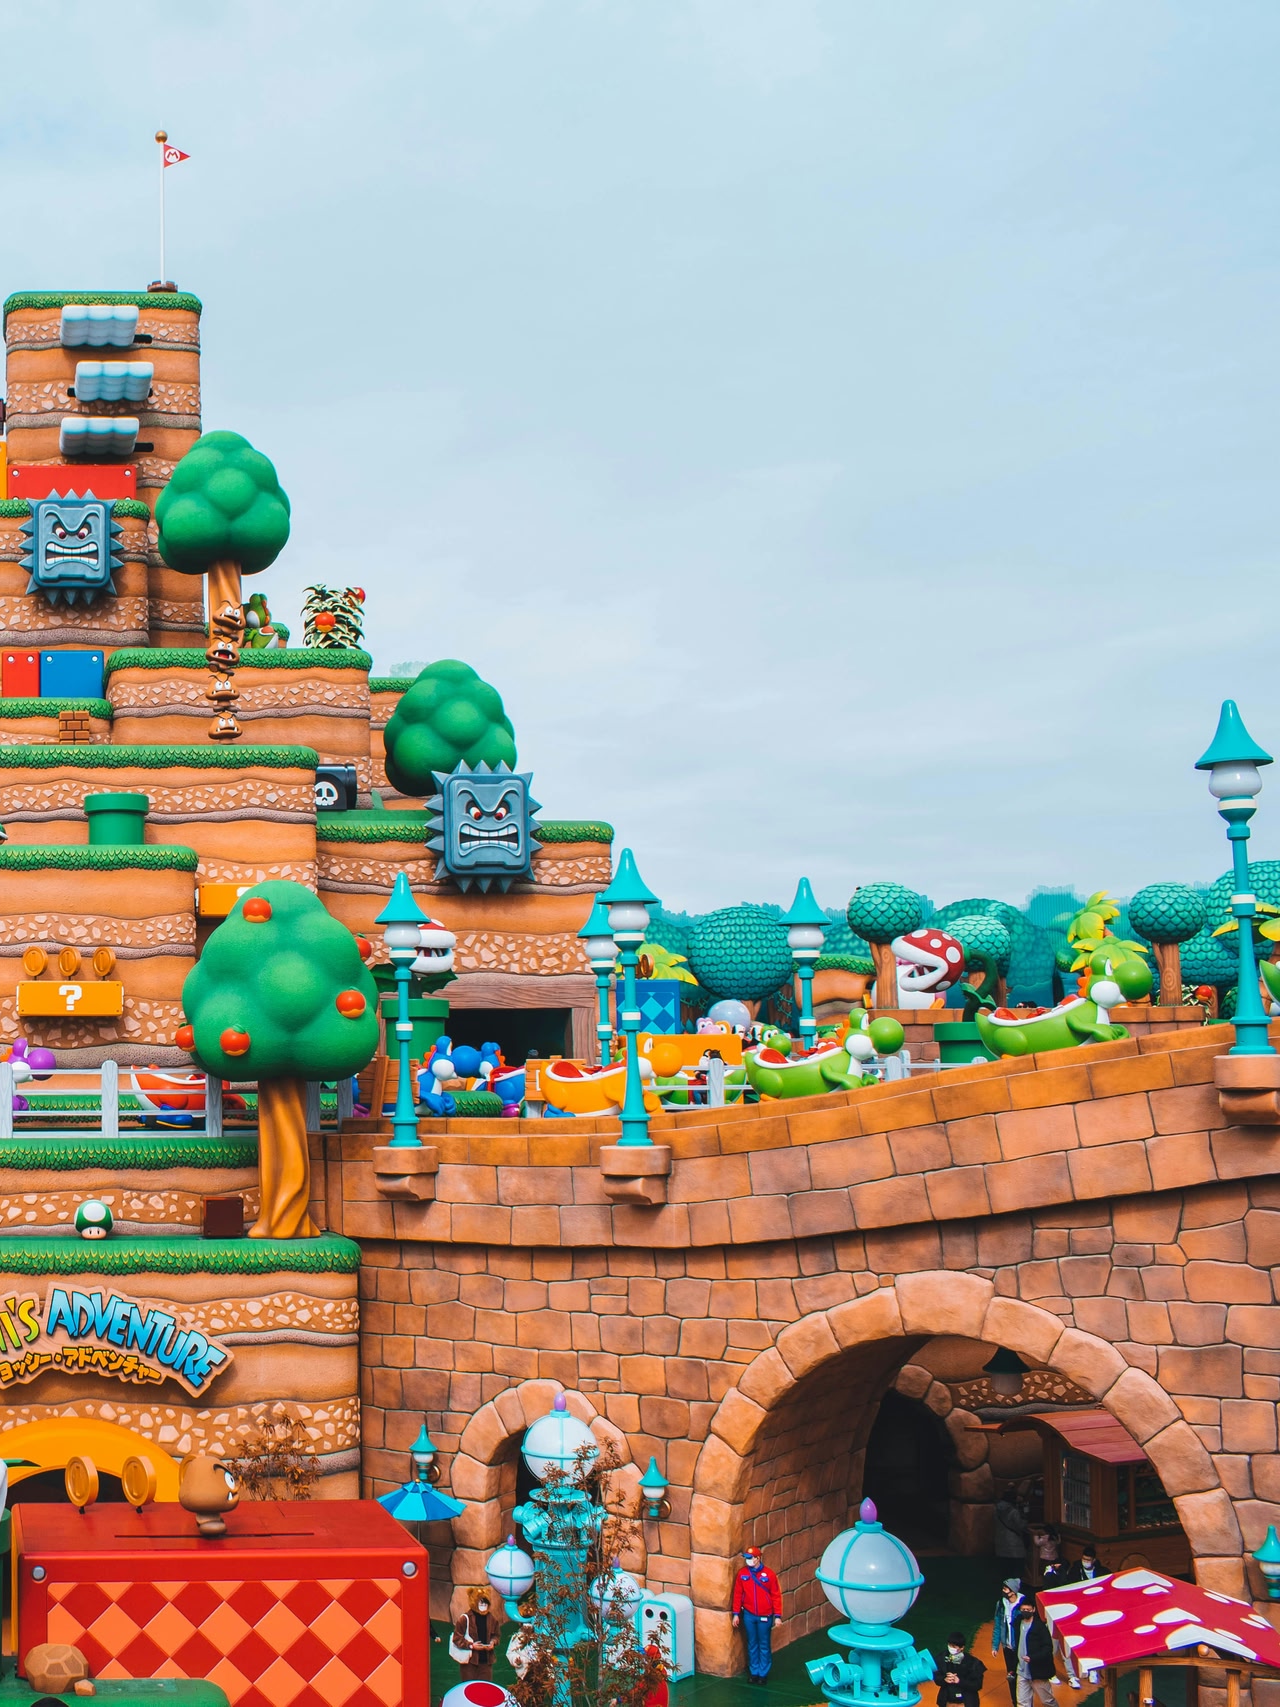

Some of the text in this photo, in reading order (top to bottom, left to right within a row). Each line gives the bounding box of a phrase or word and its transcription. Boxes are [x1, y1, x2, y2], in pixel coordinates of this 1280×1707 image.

[167, 151, 179, 160] M
[58, 984, 82, 1011] ?
[46, 1289, 227, 1388] ADVENTURE
